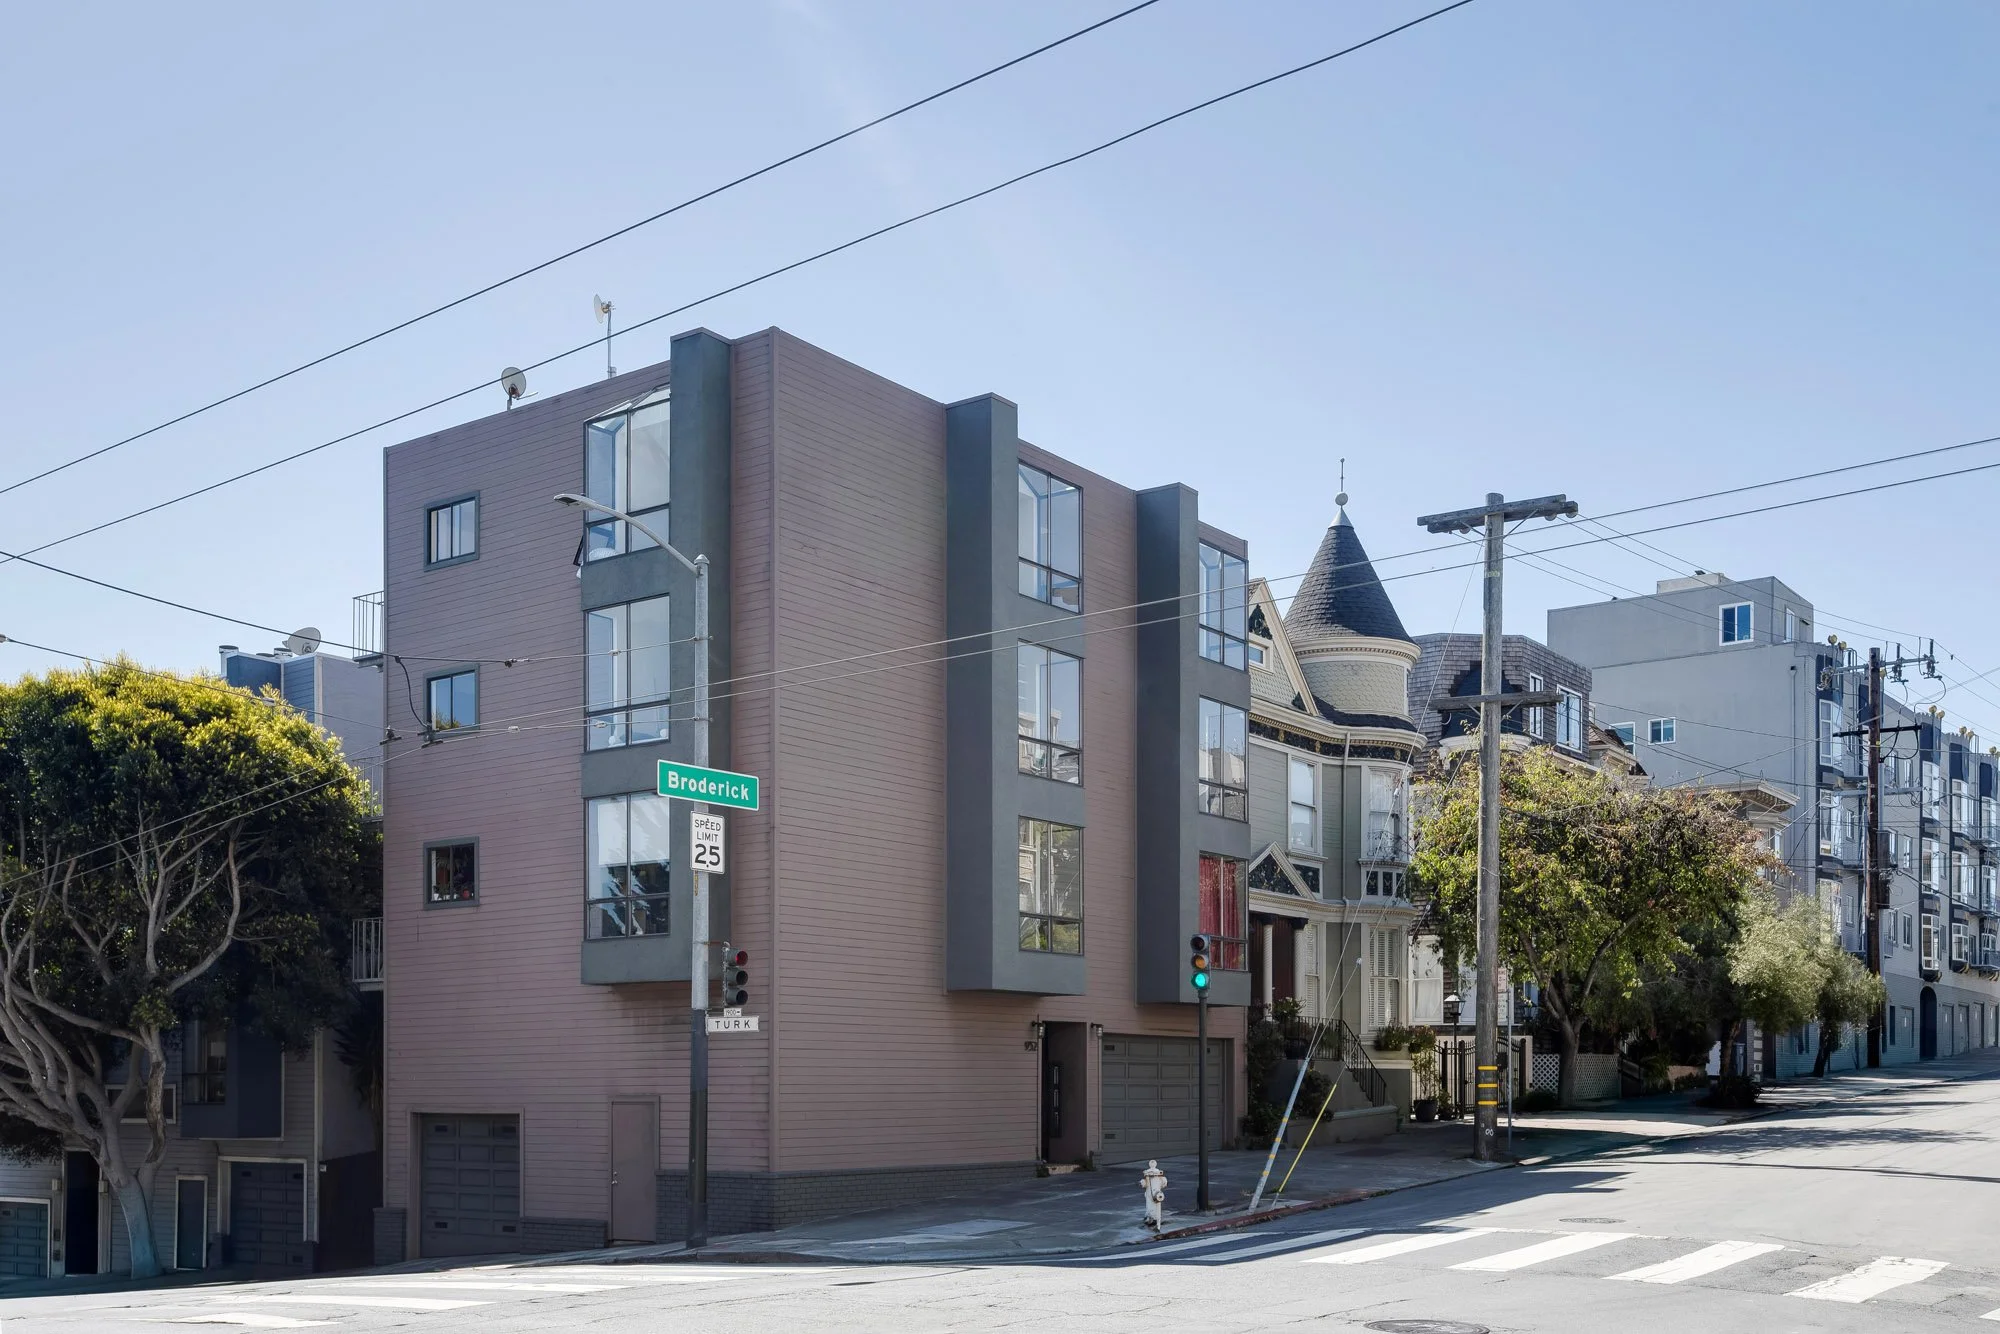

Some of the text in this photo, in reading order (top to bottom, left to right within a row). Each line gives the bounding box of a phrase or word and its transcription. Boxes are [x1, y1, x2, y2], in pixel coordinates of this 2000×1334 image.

[668, 771, 749, 801] Broderick
[694, 819, 721, 831] SPEED
[697, 831, 718, 842] LIMIT
[695, 843, 720, 866] 25
[715, 1020, 750, 1029] TURK
